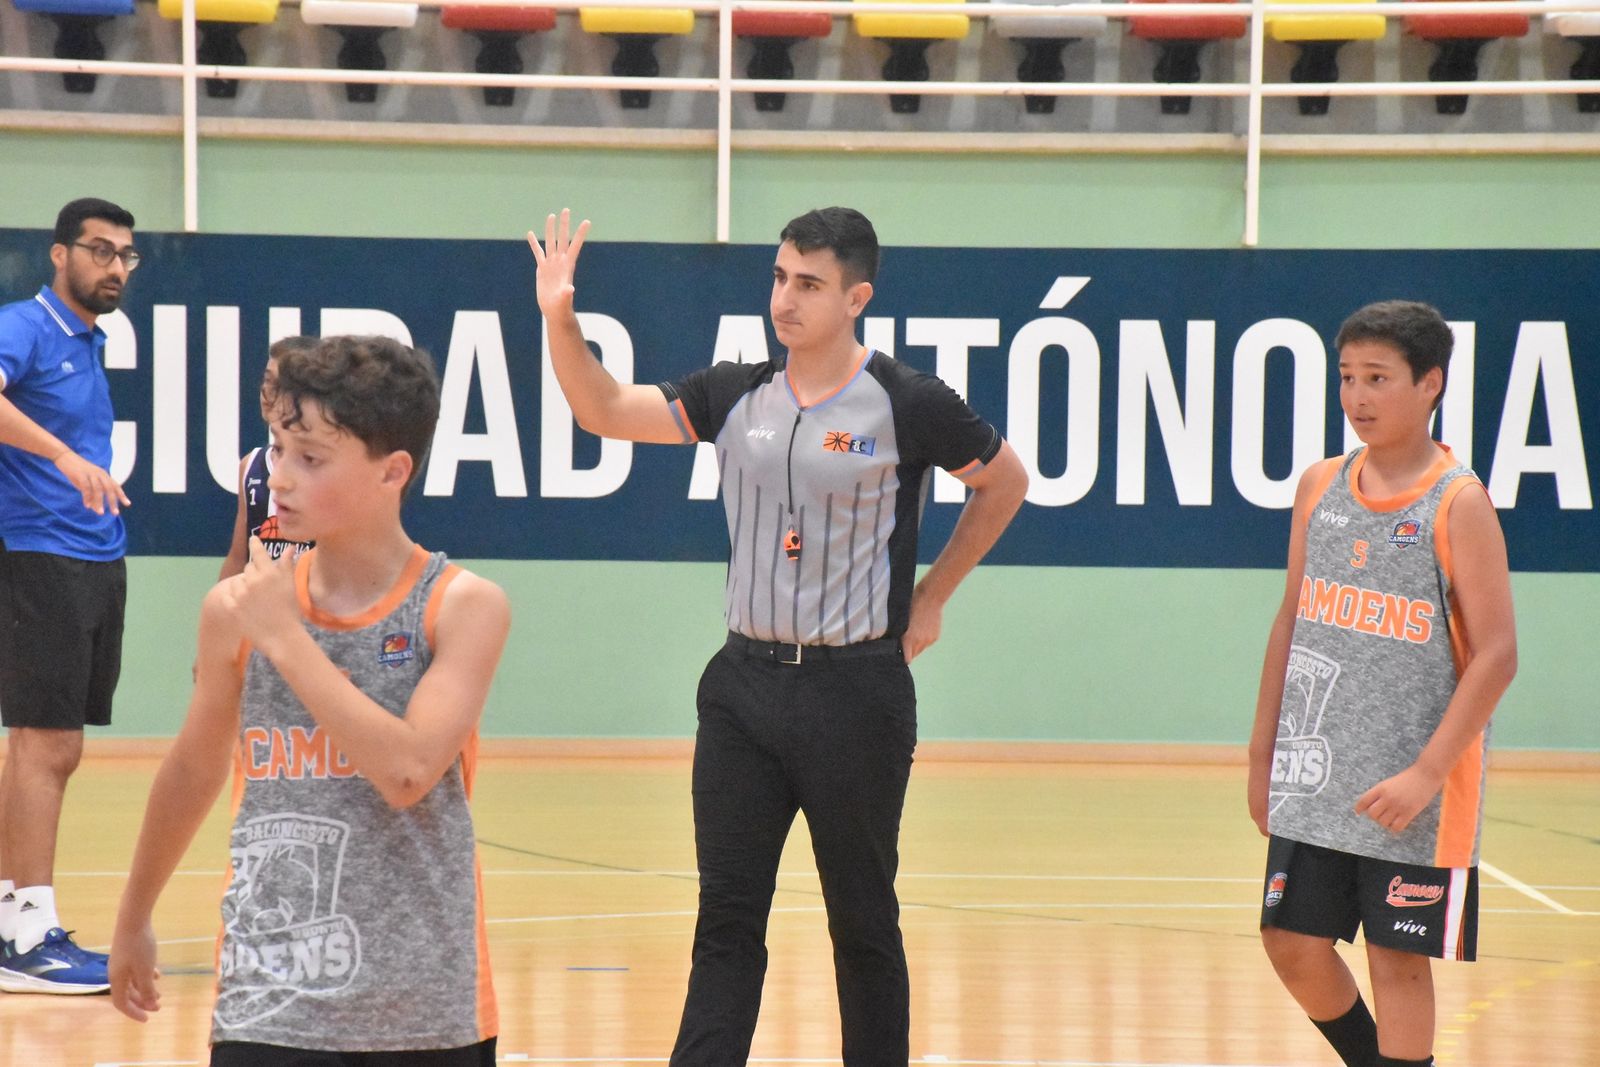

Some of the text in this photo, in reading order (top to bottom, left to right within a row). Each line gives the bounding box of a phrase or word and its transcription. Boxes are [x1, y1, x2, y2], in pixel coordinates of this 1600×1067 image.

[96, 275, 1593, 510] IUAD TÓNOA
[1349, 539, 1370, 569] 5
[244, 726, 364, 780] CAMO
